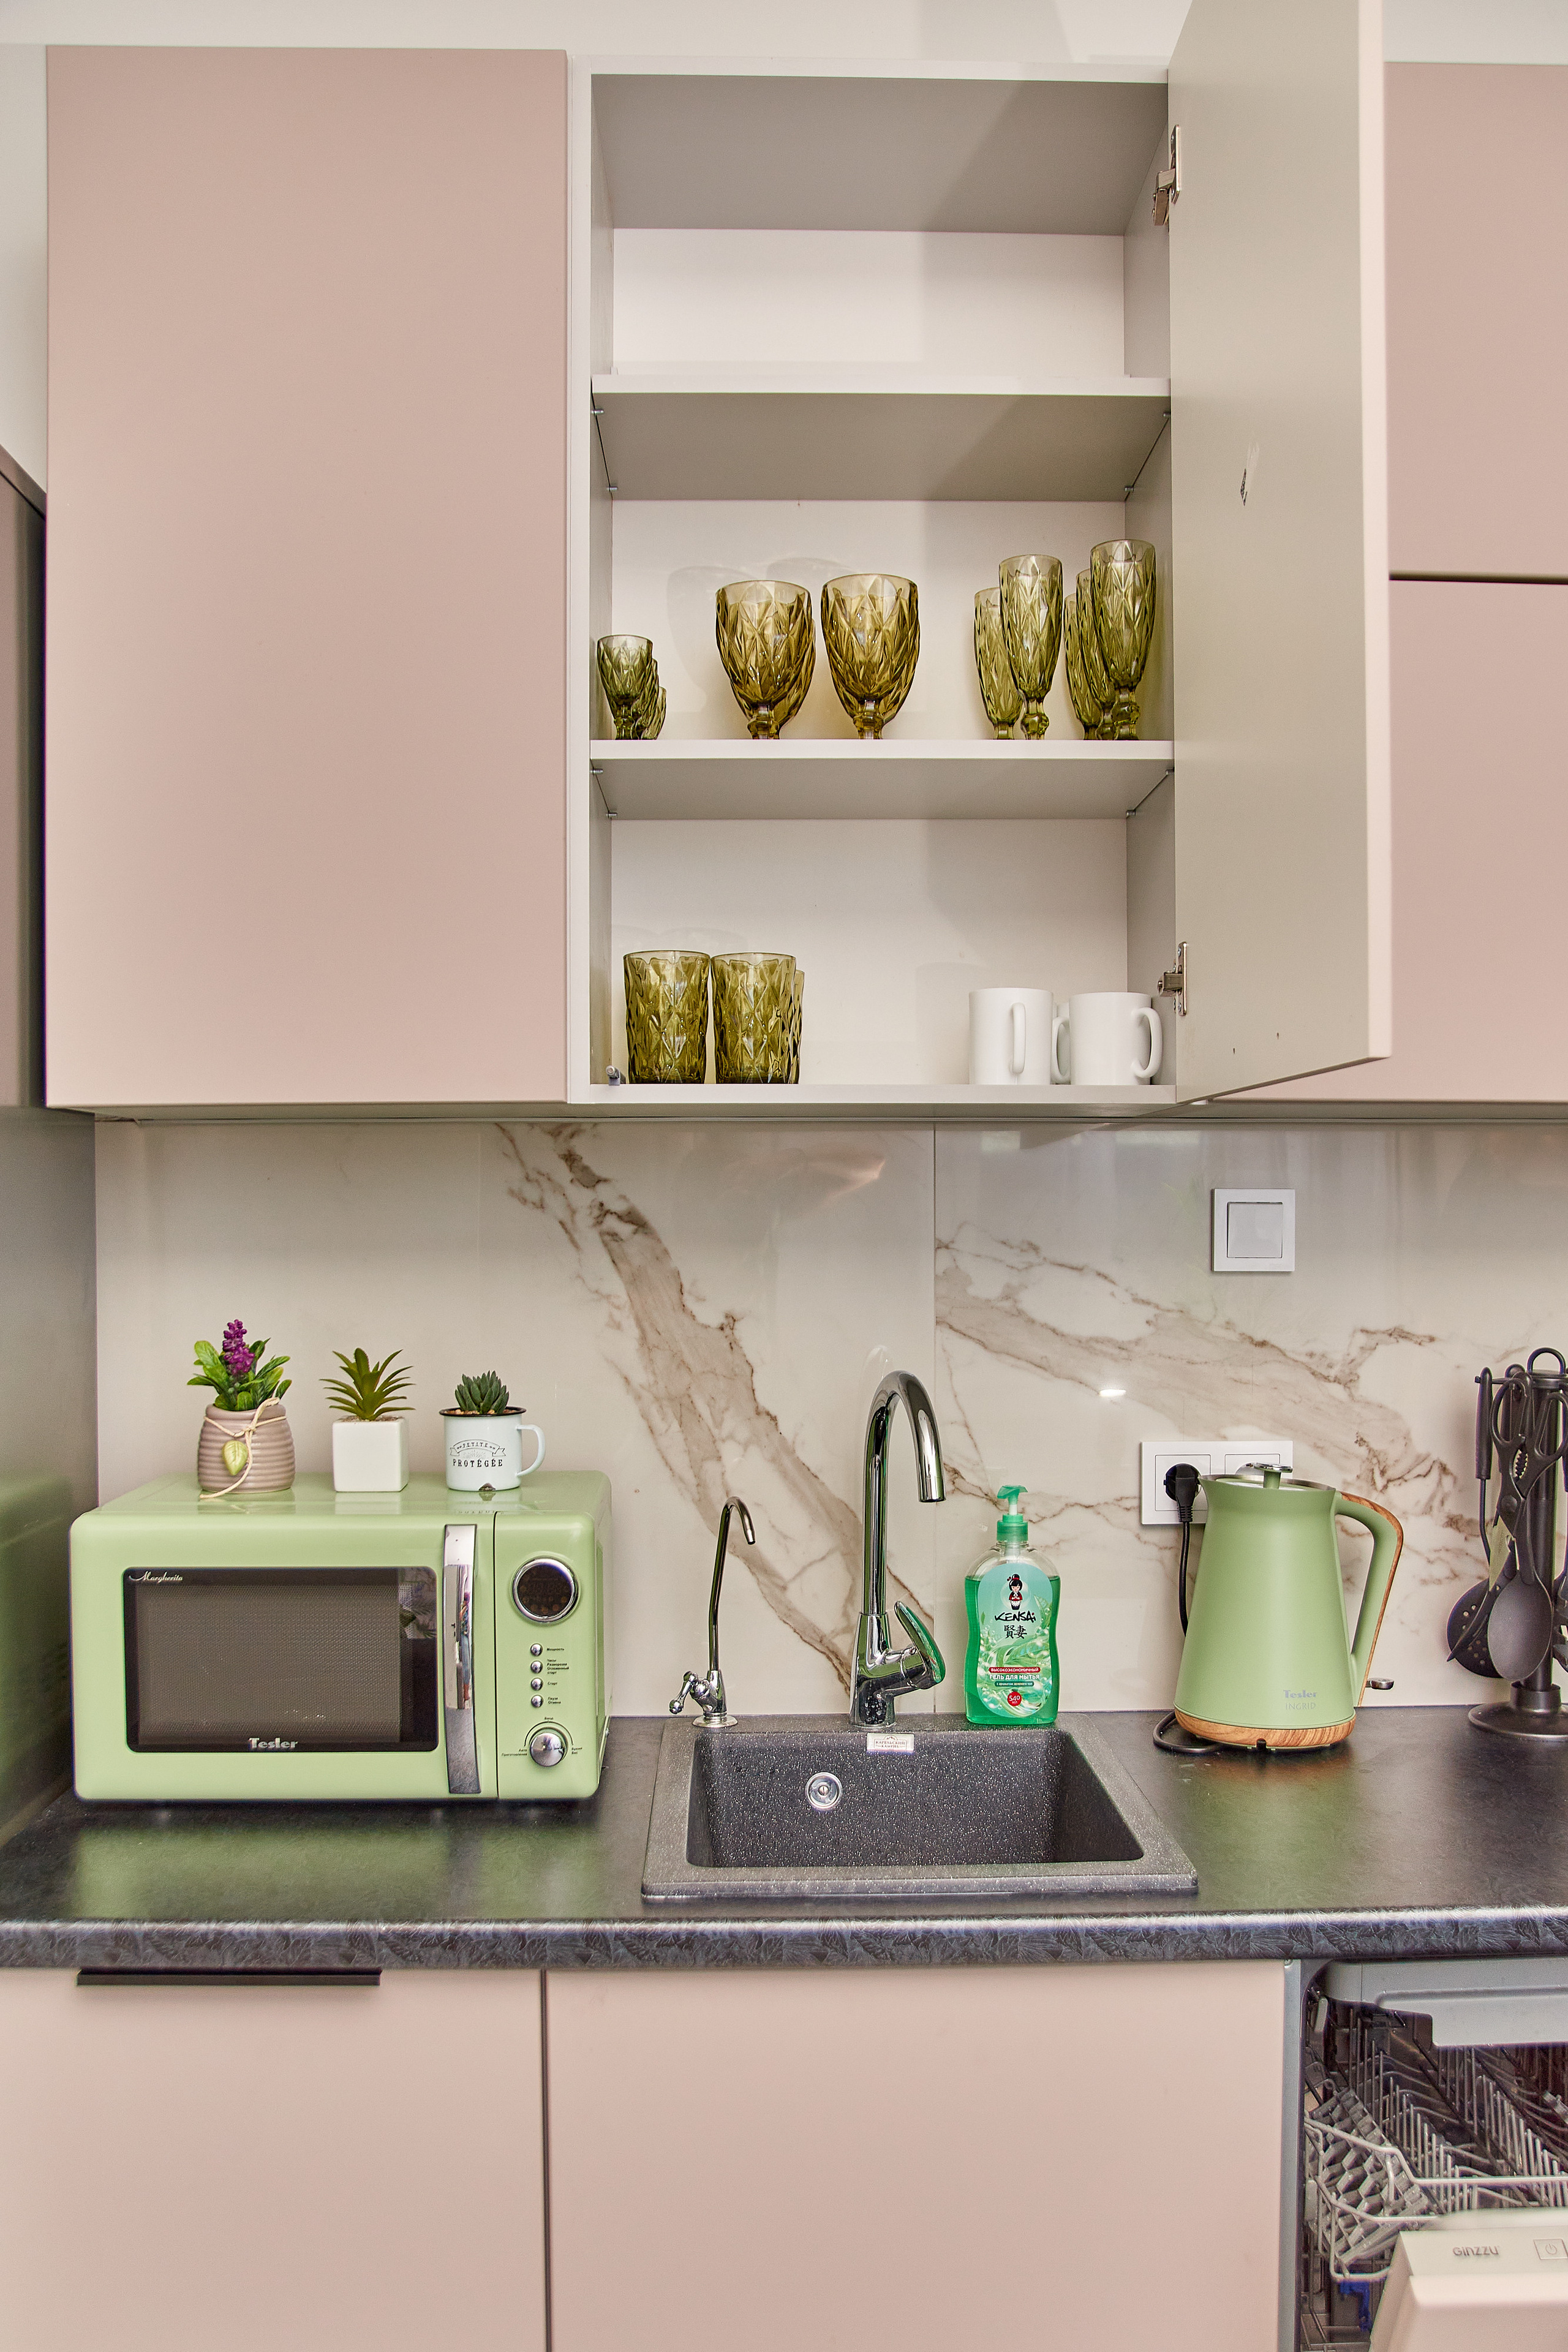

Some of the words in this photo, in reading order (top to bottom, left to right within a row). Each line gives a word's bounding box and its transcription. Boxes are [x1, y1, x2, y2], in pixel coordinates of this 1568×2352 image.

[453, 1458, 503, 1467] PROTÉGÉE
[129, 1570, 183, 1583] Margherita
[1004, 1624, 1027, 1639] 賢妻
[1283, 1689, 1317, 1698] Tesler
[249, 1737, 298, 1748] Tesler
